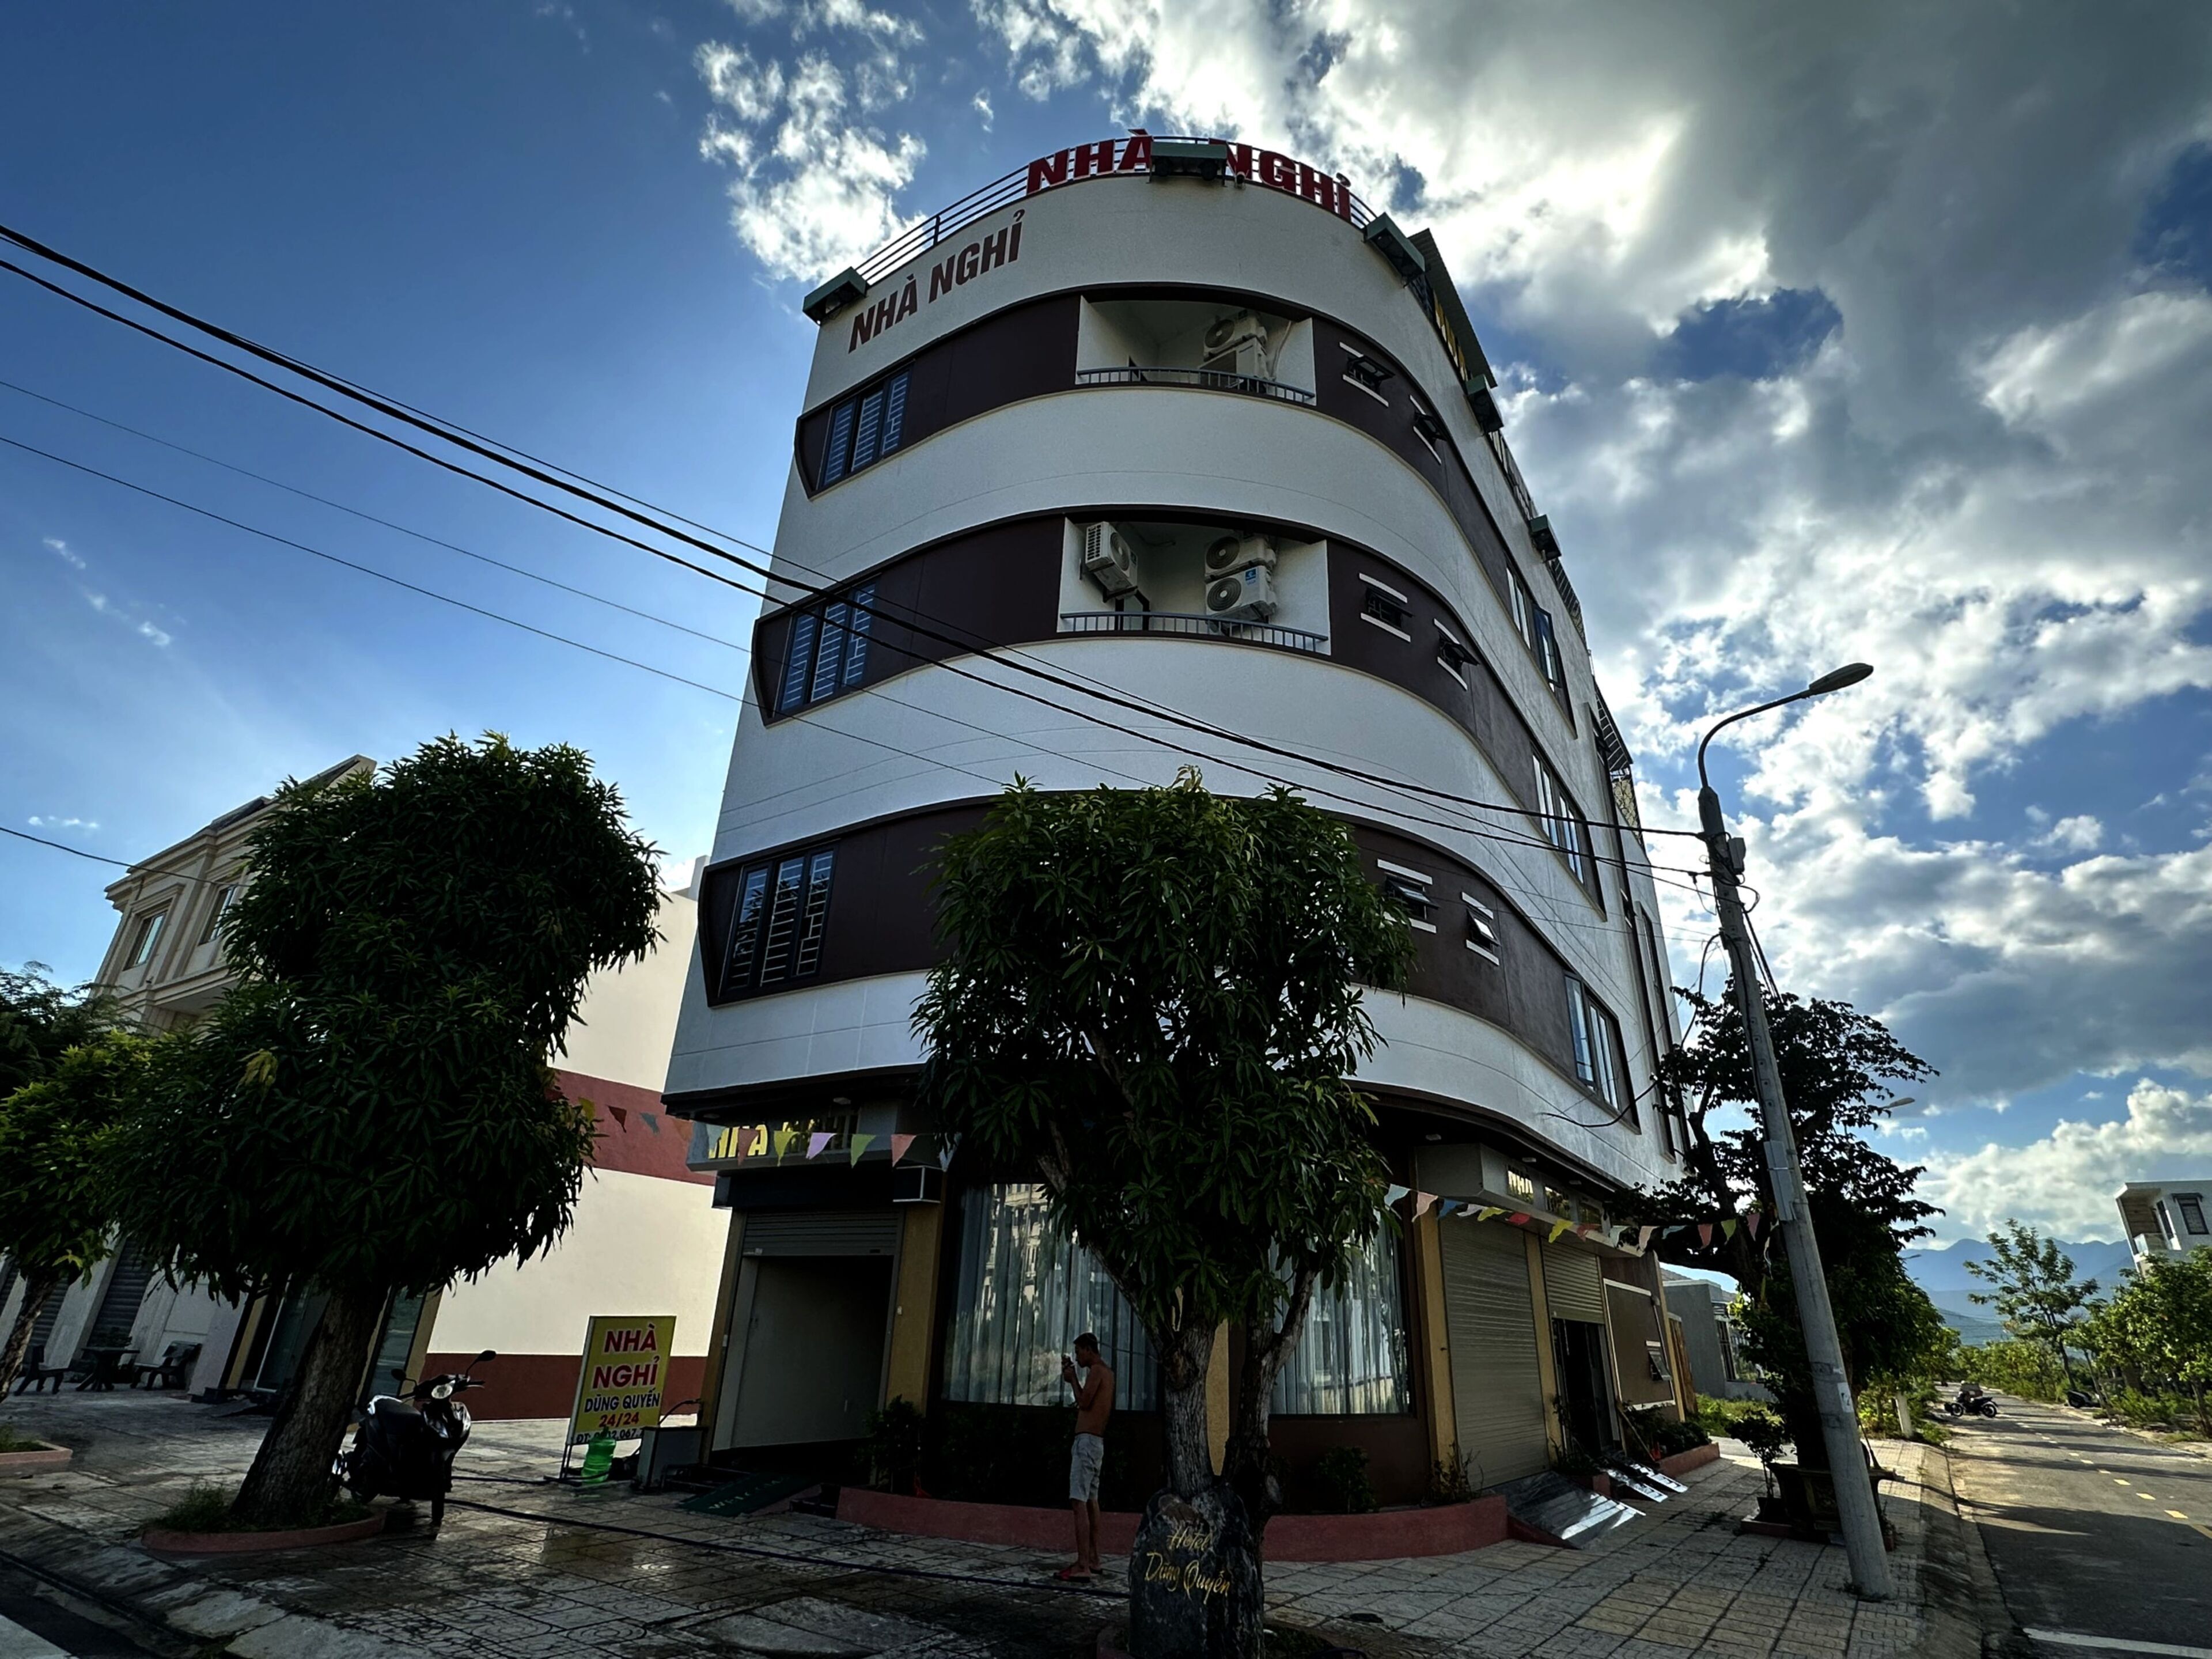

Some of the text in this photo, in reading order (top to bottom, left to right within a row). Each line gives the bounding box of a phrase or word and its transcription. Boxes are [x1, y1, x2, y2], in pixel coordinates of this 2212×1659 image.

[1027, 128, 1153, 195] NHÀ
[848, 209, 1025, 354] NHÀ NGHỈ
[604, 1324, 657, 1353] NHÀ
[592, 1355, 660, 1389] NGHỈ
[584, 1394, 619, 1412] DŨNG
[599, 1412, 639, 1427] 24/24
[1167, 1526, 1210, 1551] Hotel
